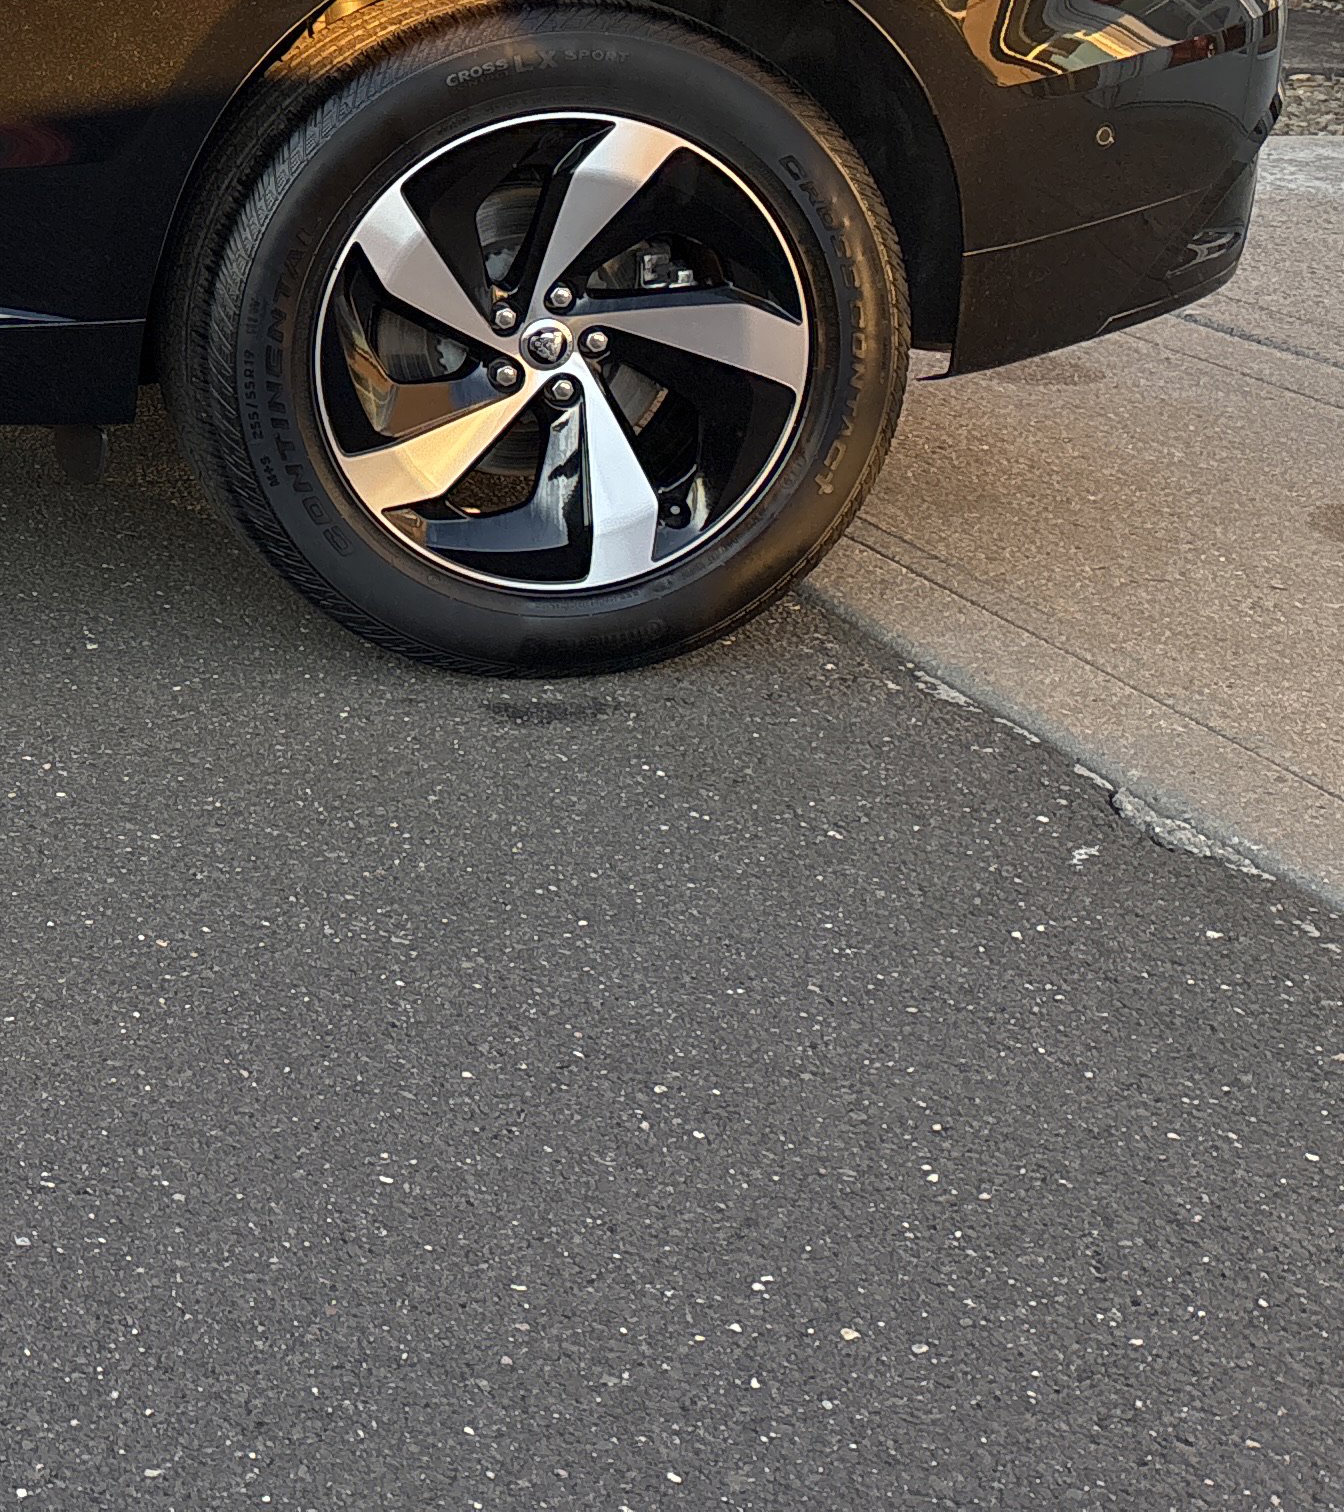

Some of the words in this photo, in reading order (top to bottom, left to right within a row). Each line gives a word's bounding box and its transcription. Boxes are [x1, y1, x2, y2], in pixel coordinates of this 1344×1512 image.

[446, 58, 509, 88] CROSS
[564, 48, 630, 63] SPORT
[243, 348, 260, 440] 255/55R19
[265, 227, 354, 557] CONTINENTAL
